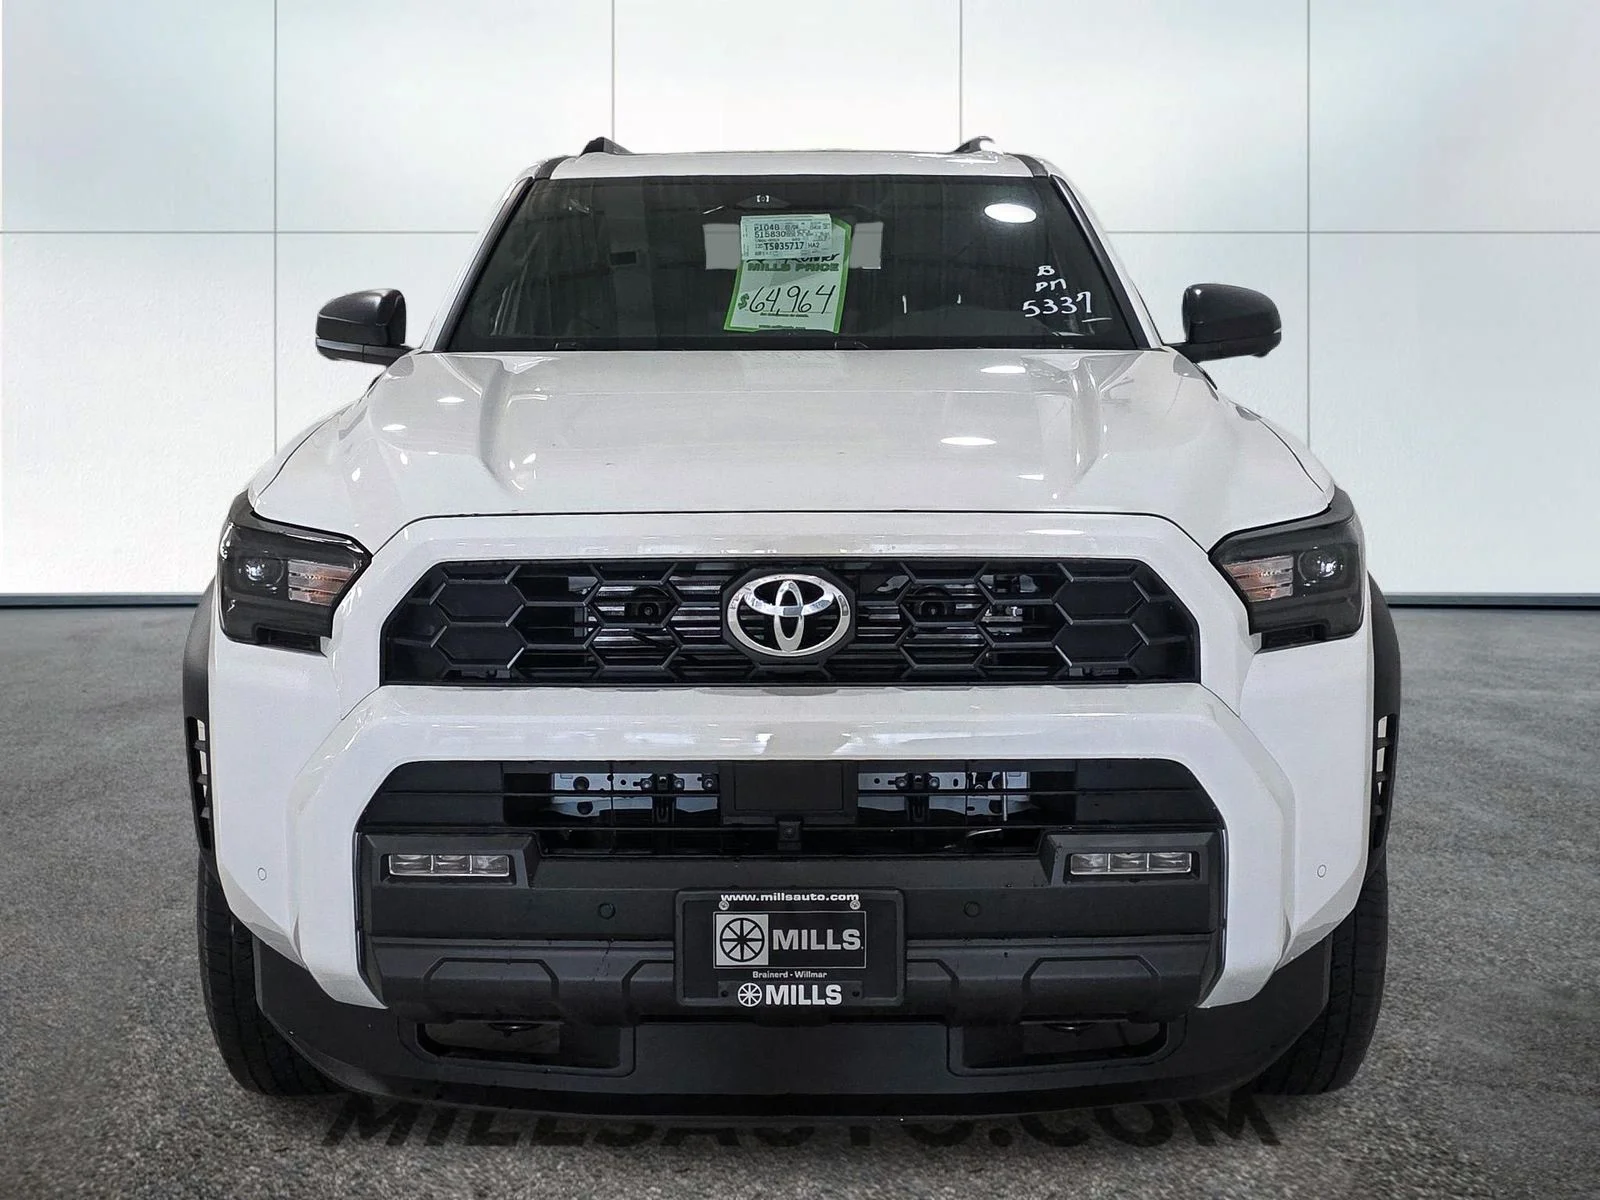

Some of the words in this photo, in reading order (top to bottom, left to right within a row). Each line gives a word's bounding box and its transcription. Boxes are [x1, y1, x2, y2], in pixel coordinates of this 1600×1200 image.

[795, 263, 839, 272] PRICE
[1022, 291, 1092, 317] 5337
[720, 893, 859, 902] www.millsauto.com
[766, 985, 842, 1005] MILLS
